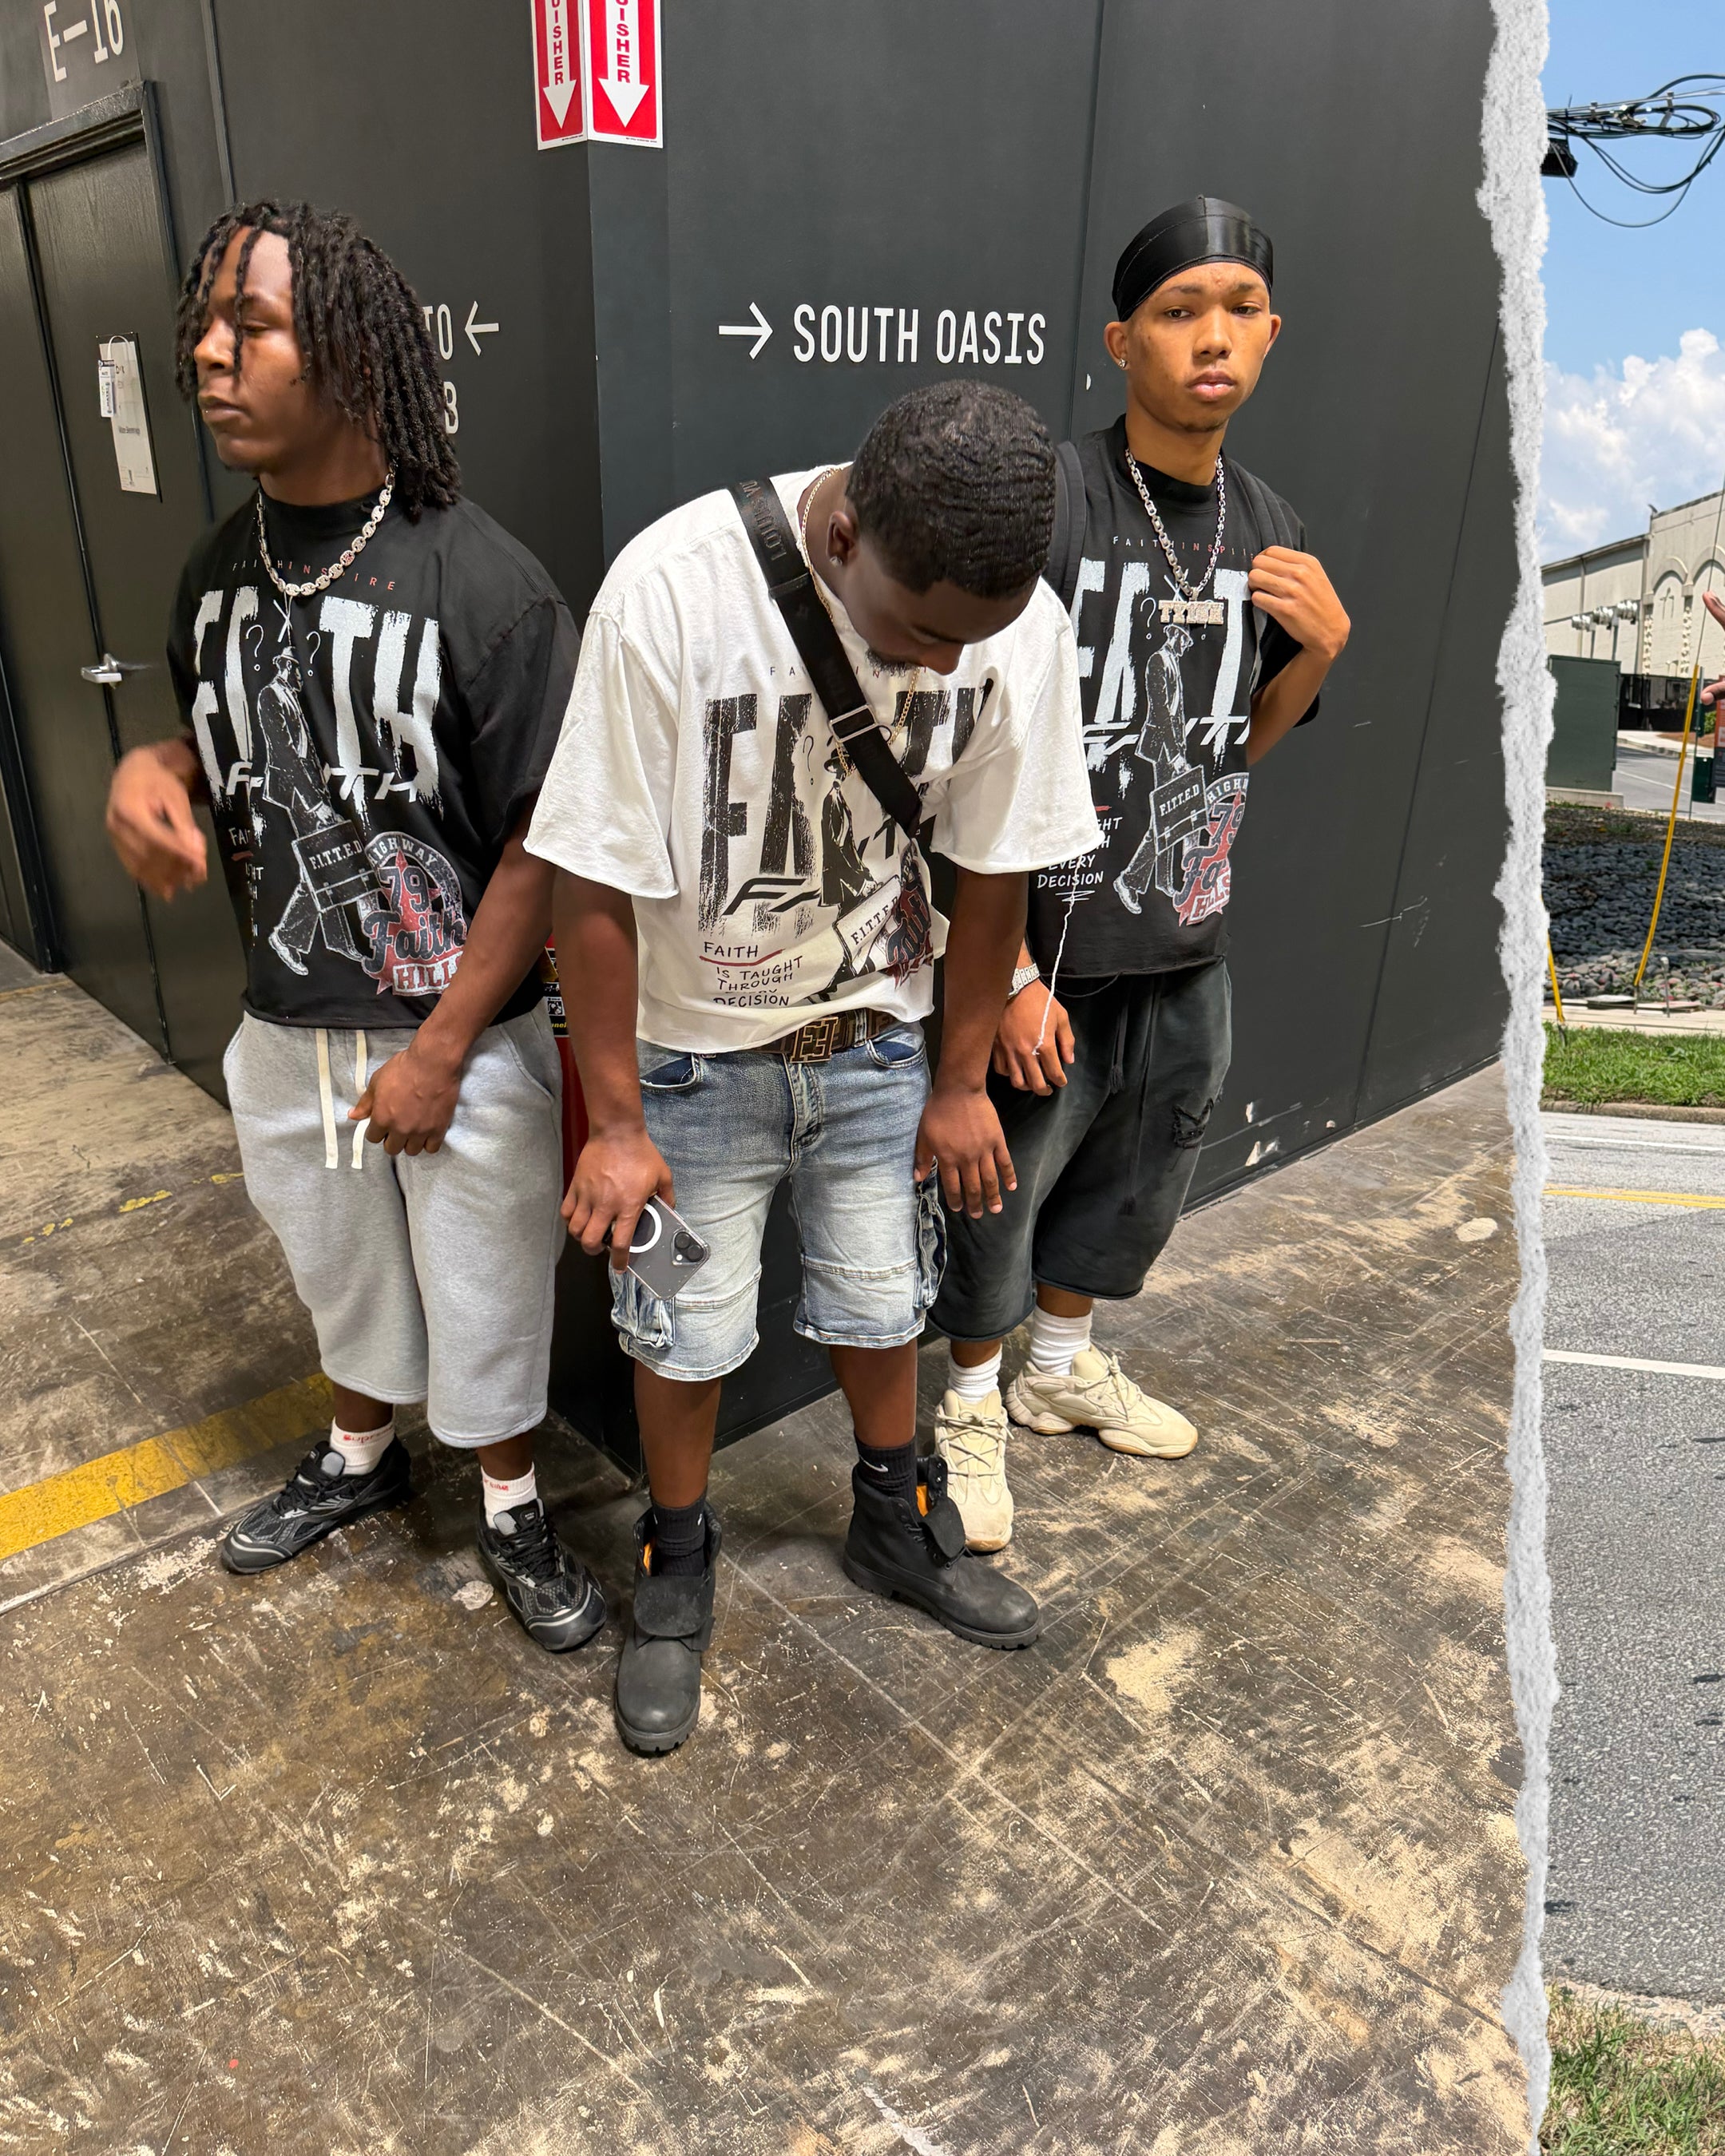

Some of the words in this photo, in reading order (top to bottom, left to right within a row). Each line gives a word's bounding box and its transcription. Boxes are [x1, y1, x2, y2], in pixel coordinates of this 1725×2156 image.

[44, 0, 124, 82] E-16
[793, 303, 919, 363] SOUTH
[936, 309, 1046, 365] OASIS
[192, 585, 442, 826] FATH
[1207, 778, 1249, 804] HIGH
[378, 866, 431, 915] 79
[1037, 870, 1104, 888] DECISION
[362, 907, 467, 974] Faith
[704, 941, 759, 958] FAITH
[395, 958, 457, 989] HILL
[716, 967, 730, 978] IS
[740, 955, 803, 981] TAUGHT
[717, 973, 793, 990] THROUGH
